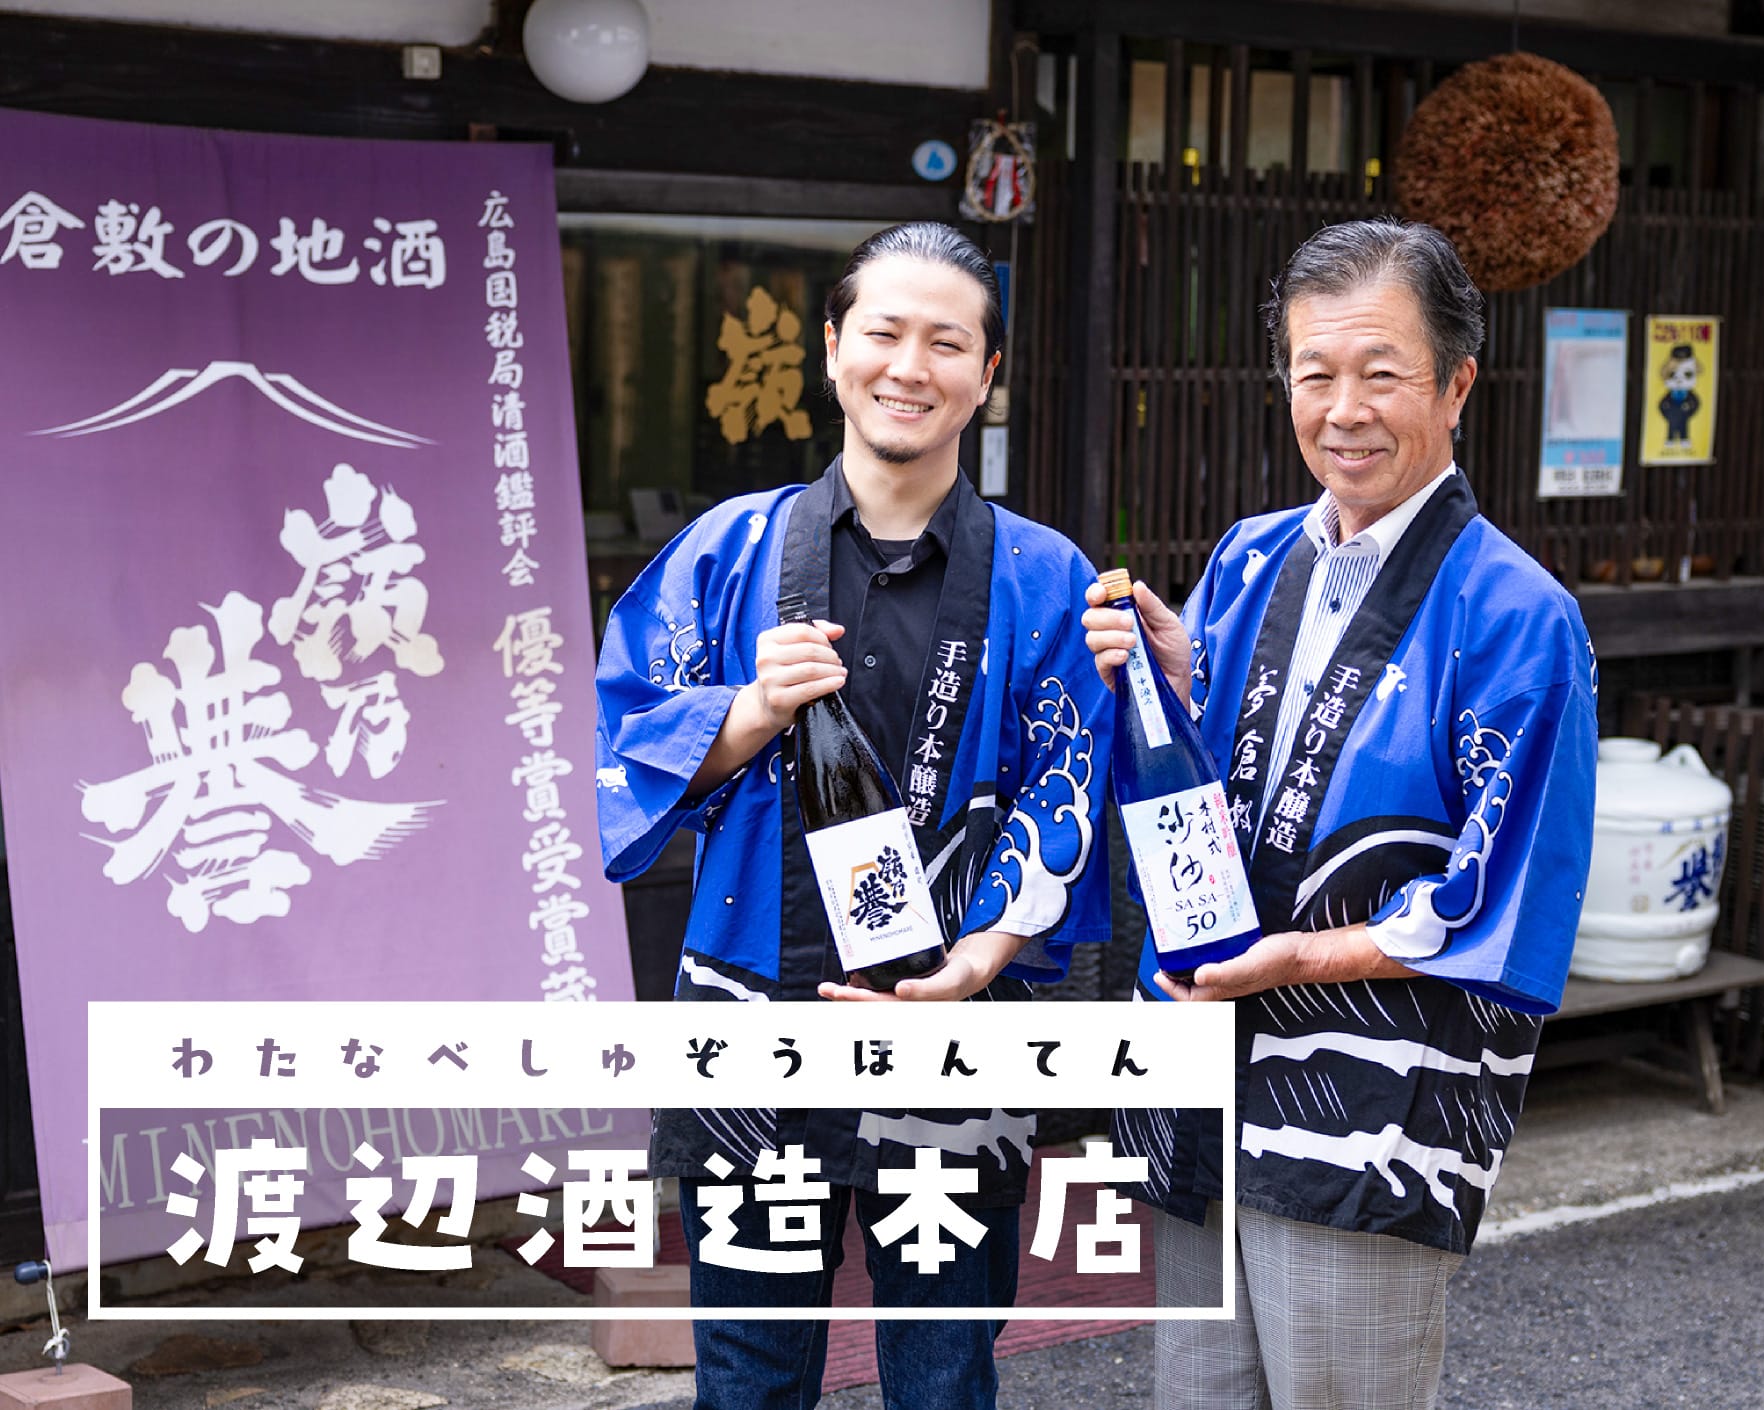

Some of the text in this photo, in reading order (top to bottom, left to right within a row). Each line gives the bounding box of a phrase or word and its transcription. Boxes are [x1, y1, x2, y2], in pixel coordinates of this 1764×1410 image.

[0, 190, 447, 290] 倉敷の地酒
[478, 190, 540, 586] 広島国税局清酒鑑評会
[906, 639, 968, 827] 手造り本醸造
[1265, 663, 1362, 854] 手造り本醸造
[1187, 910, 1217, 941] 50
